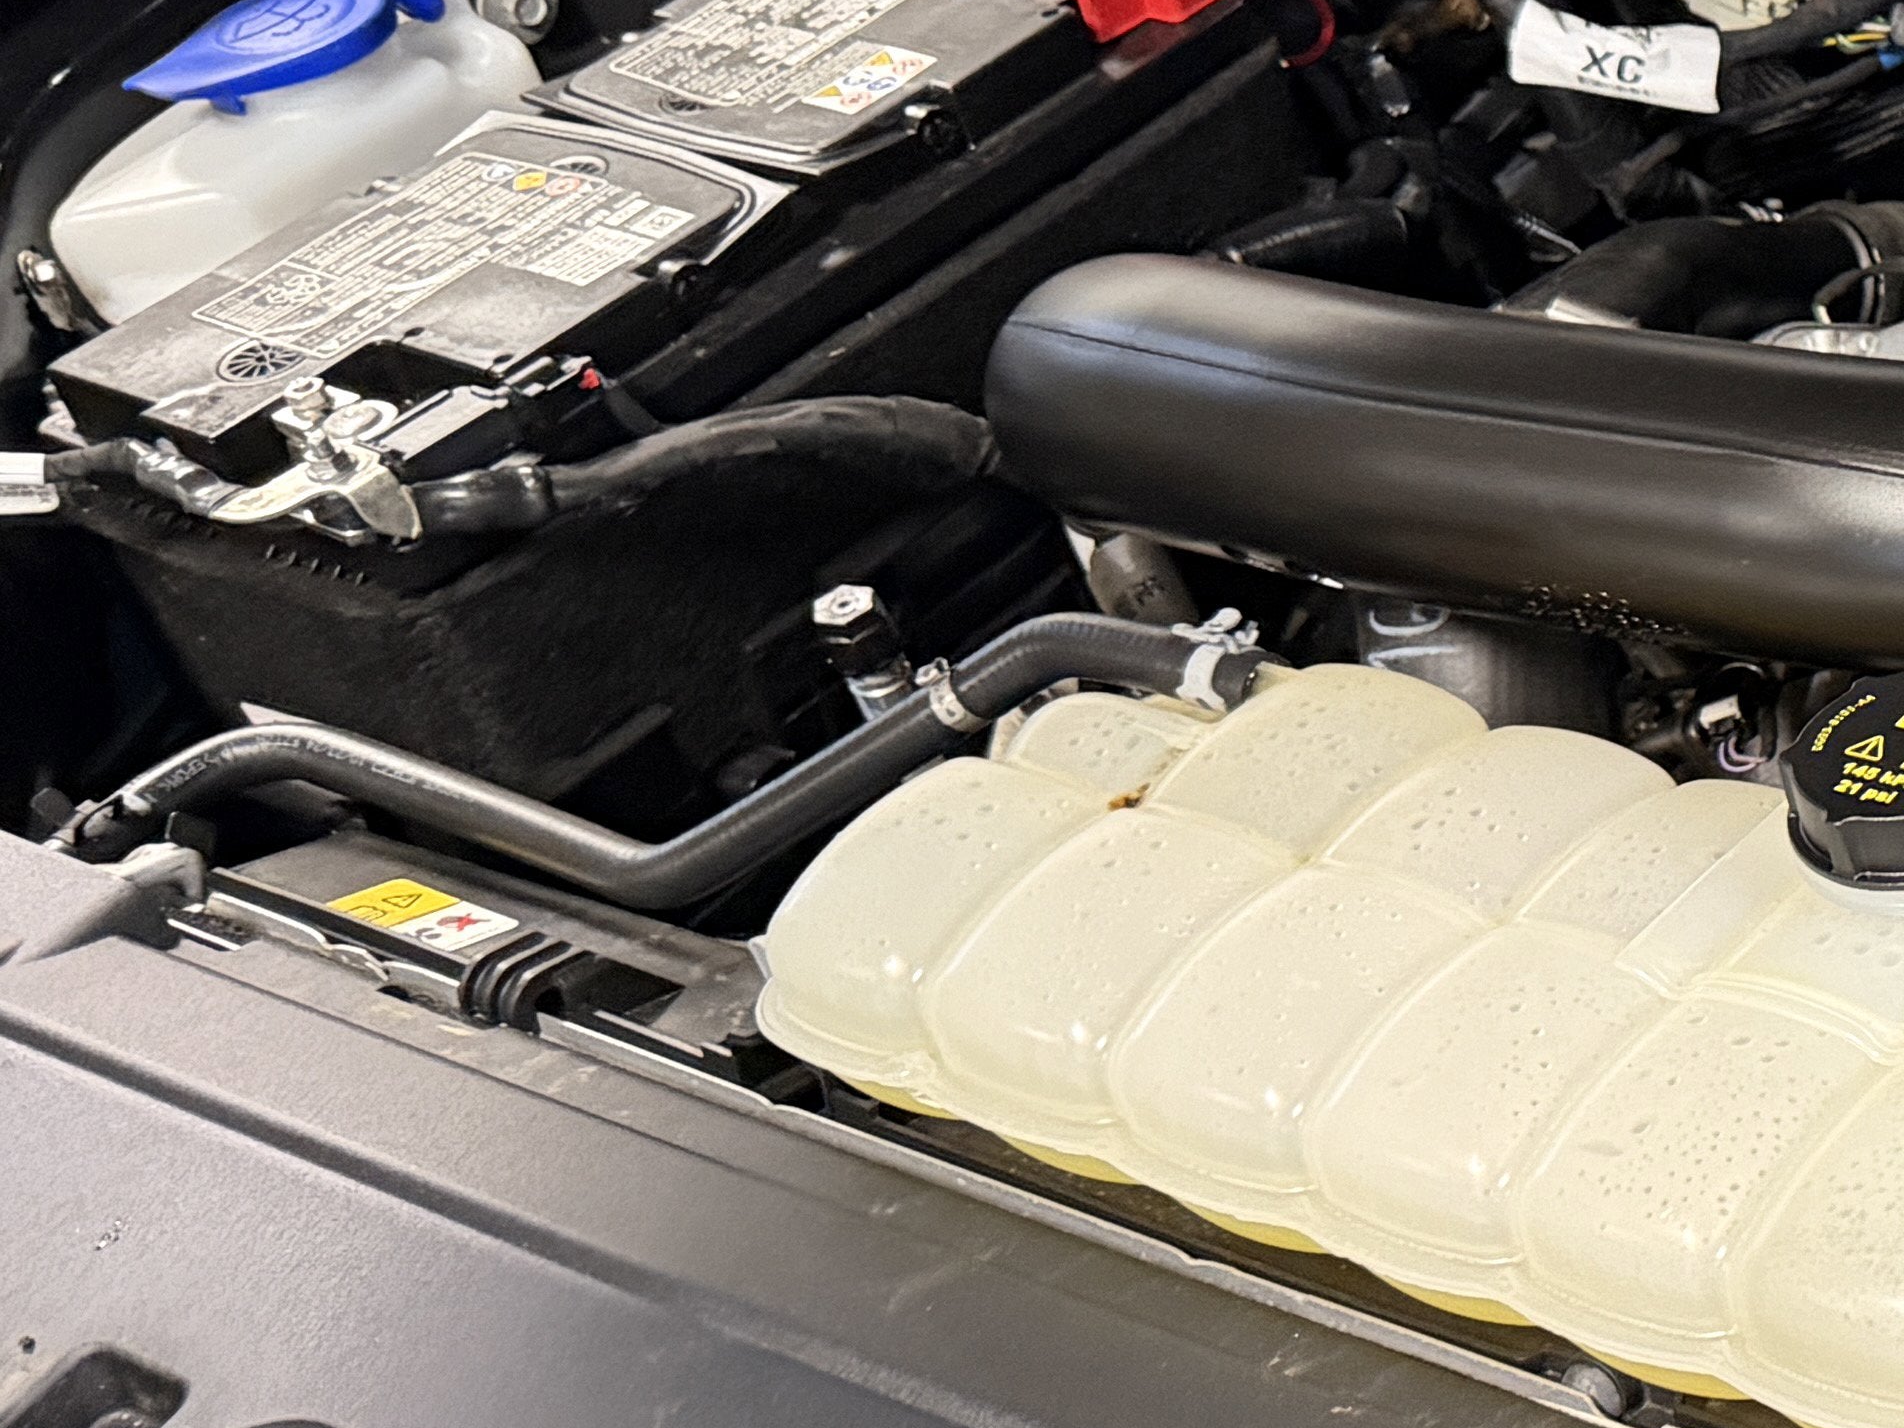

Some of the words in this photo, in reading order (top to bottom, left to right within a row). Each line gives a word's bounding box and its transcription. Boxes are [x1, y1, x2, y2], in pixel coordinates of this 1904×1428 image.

[1581, 45, 1646, 85] XC
[1842, 762, 1881, 780] 145
[1833, 779, 1863, 795] 21
[1859, 788, 1899, 804] psi
